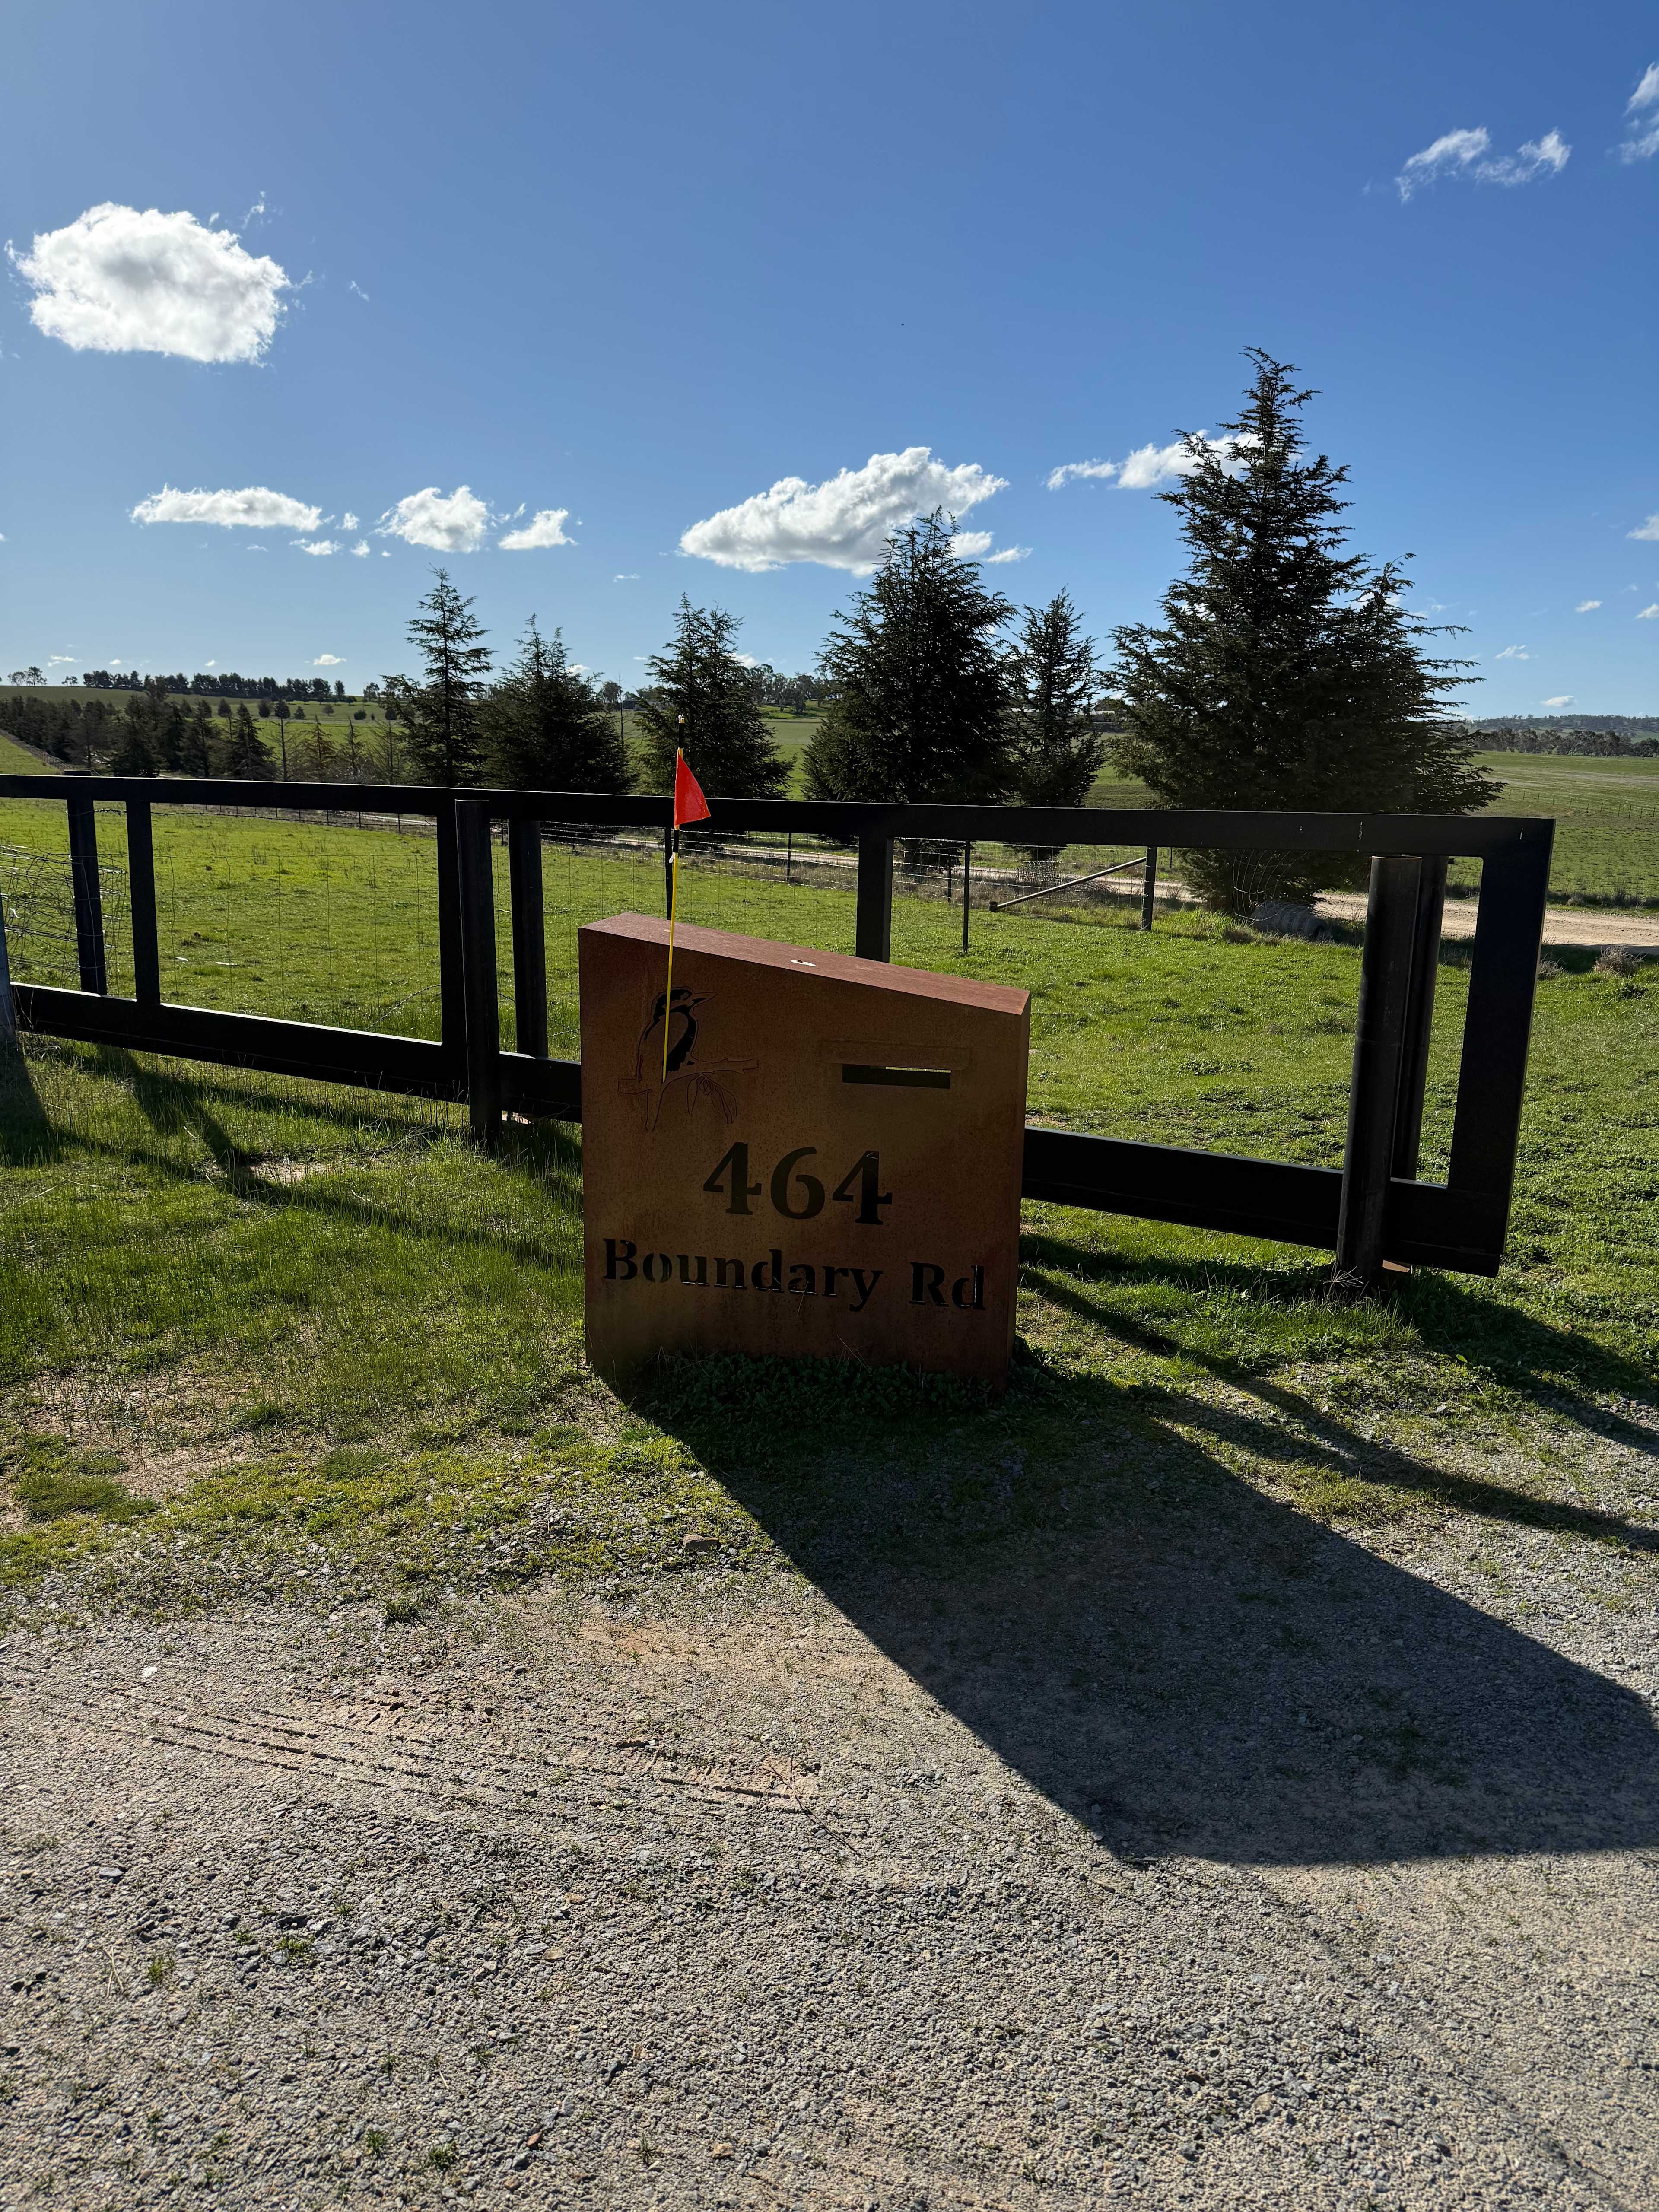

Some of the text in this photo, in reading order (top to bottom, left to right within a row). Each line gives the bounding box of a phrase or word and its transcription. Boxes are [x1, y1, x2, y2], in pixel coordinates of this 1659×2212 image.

[703, 1141, 893, 1225] 464
[603, 1237, 986, 1312] Boundary Rd
